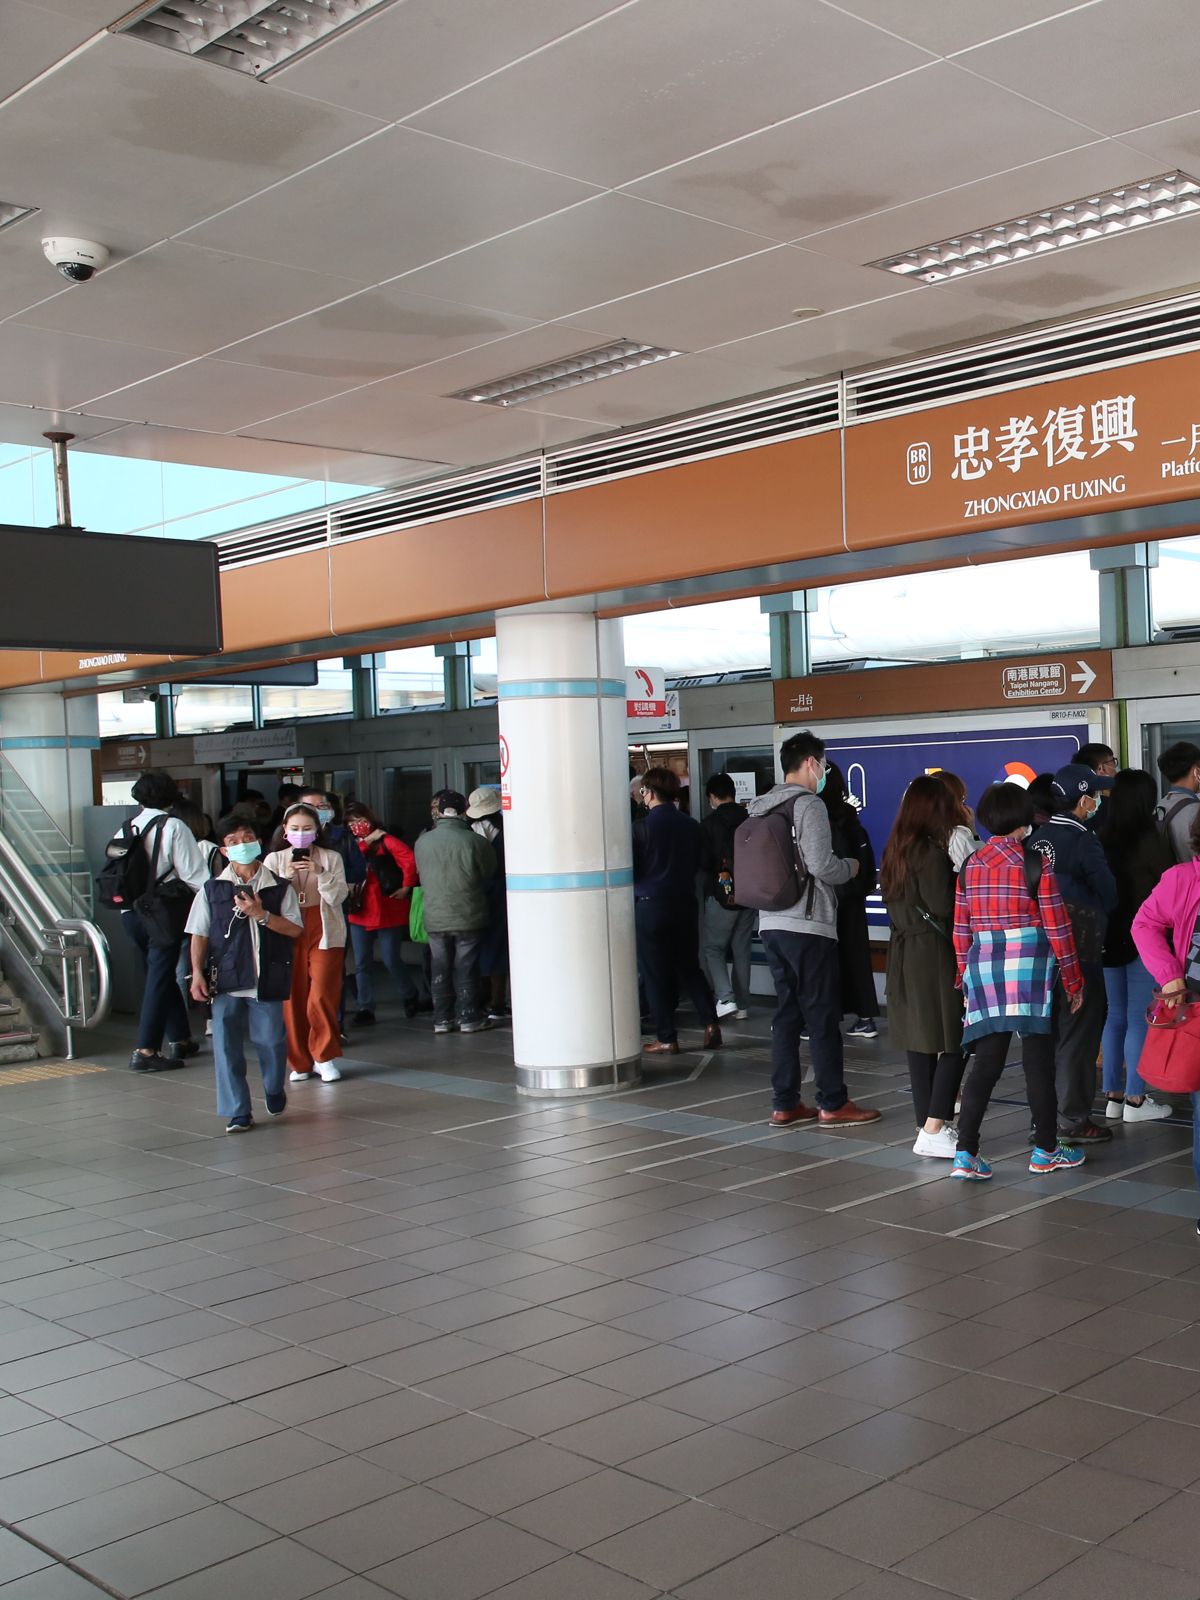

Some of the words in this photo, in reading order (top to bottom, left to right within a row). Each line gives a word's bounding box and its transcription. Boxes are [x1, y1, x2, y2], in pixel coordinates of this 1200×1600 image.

[951, 395, 1139, 481] 忠孝復興
[910, 449, 927, 463] BR
[912, 466, 926, 480] 10
[964, 485, 1060, 518] ZHONGXIAO
[1063, 475, 1126, 501] FUXING
[1007, 666, 1061, 681] 南港展覽館
[1030, 680, 1059, 689] Nangang
[1008, 689, 1039, 697] Exhibition
[1040, 687, 1062, 695] Center
[790, 694, 813, 705] 一月台
[1051, 709, 1087, 719] BR10-F-M02
